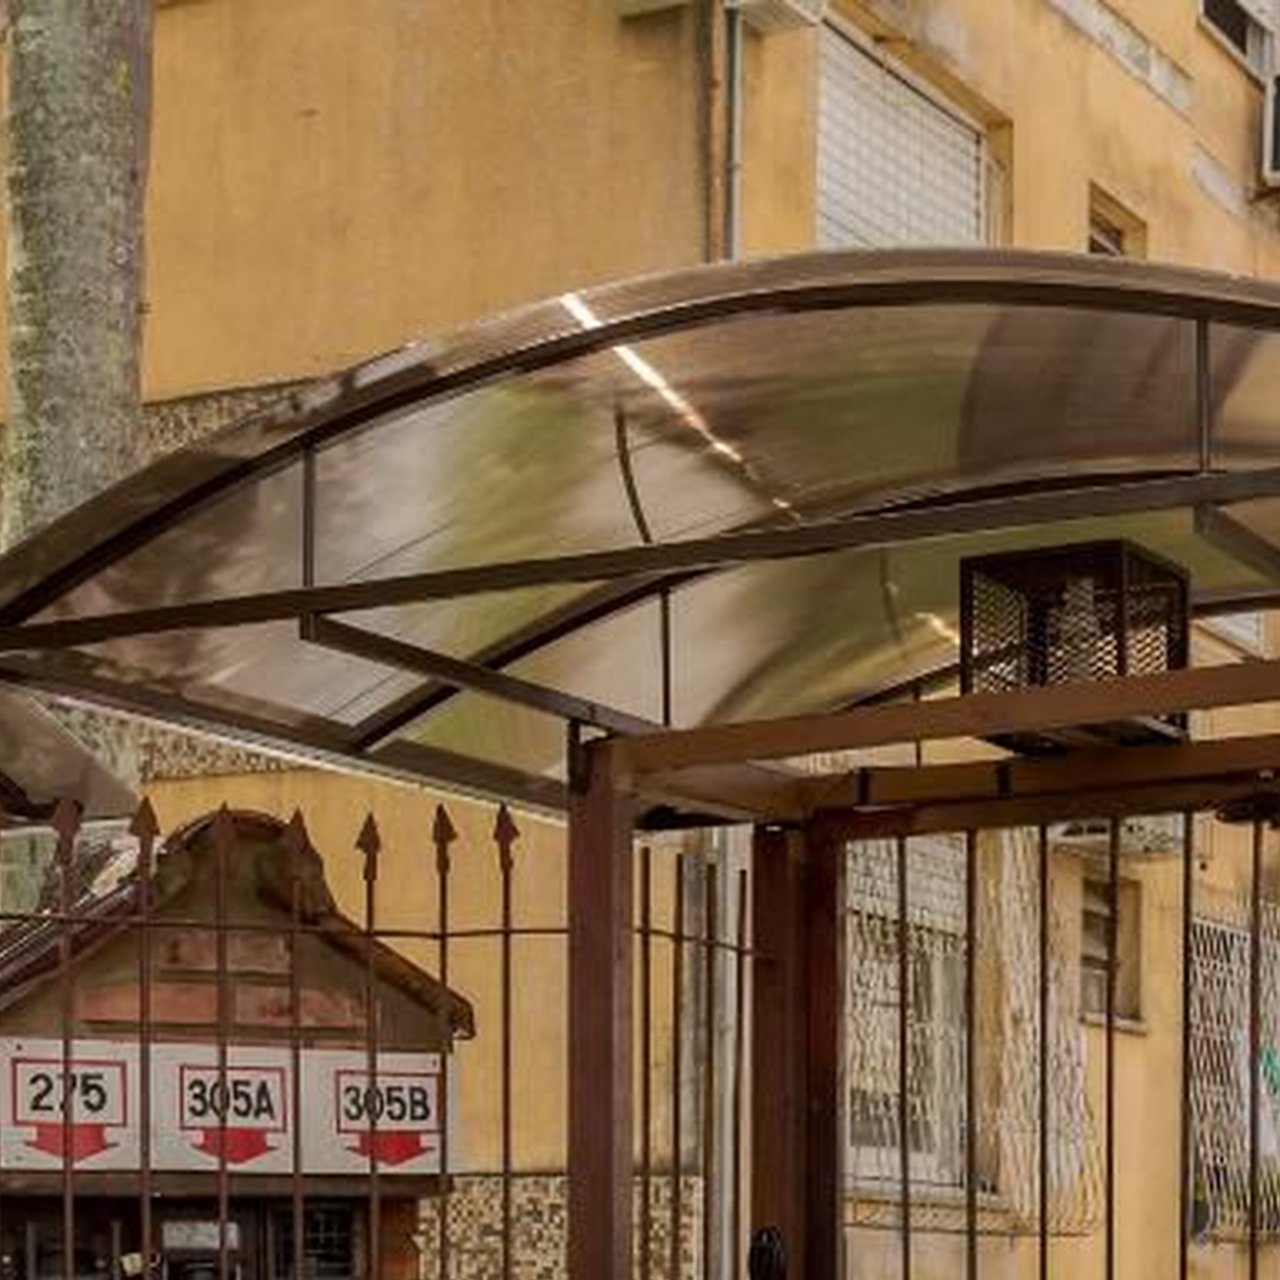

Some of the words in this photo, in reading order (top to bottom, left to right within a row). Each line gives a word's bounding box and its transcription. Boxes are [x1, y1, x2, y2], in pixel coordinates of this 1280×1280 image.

[29, 1072, 107, 1113] 275
[188, 1079, 275, 1120] 305A
[344, 1084, 431, 1122] 305B
